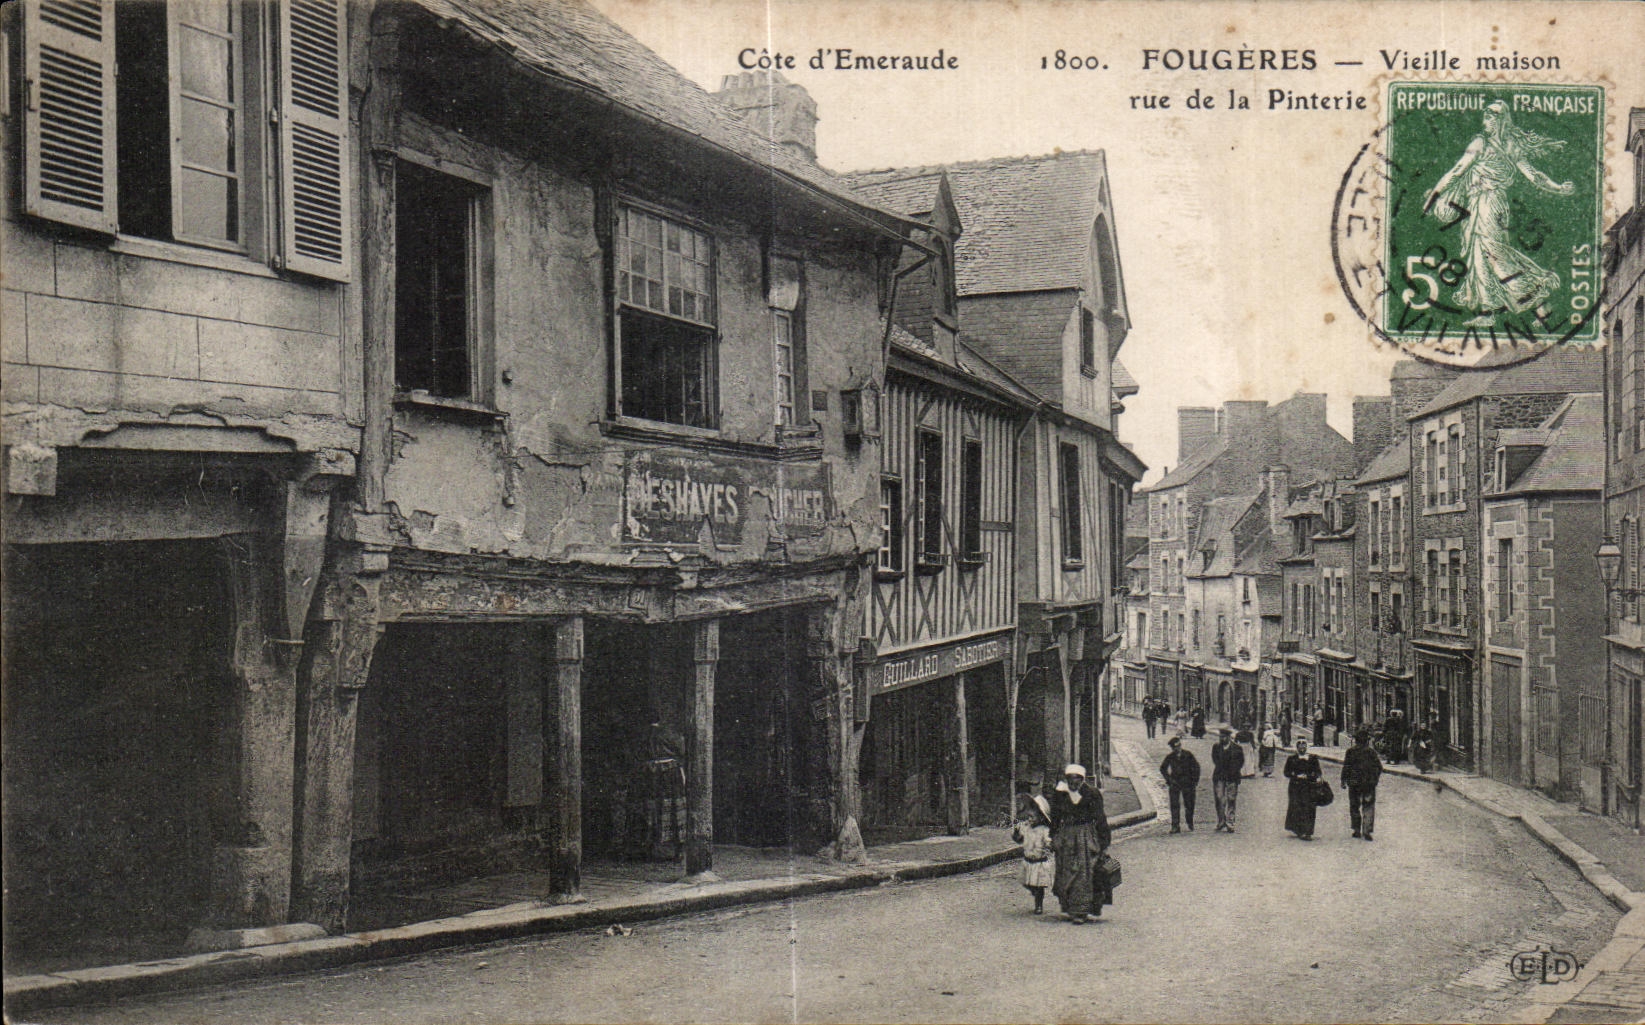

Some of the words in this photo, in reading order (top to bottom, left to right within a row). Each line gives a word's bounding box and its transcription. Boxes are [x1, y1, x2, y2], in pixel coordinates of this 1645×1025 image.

[1512, 93, 1596, 116] FRANÇAISE
[1401, 256, 1440, 310] 5
[1570, 243, 1592, 325] POSTES
[882, 653, 939, 688] GUILLARD
[954, 640, 999, 669] SABOTIER
